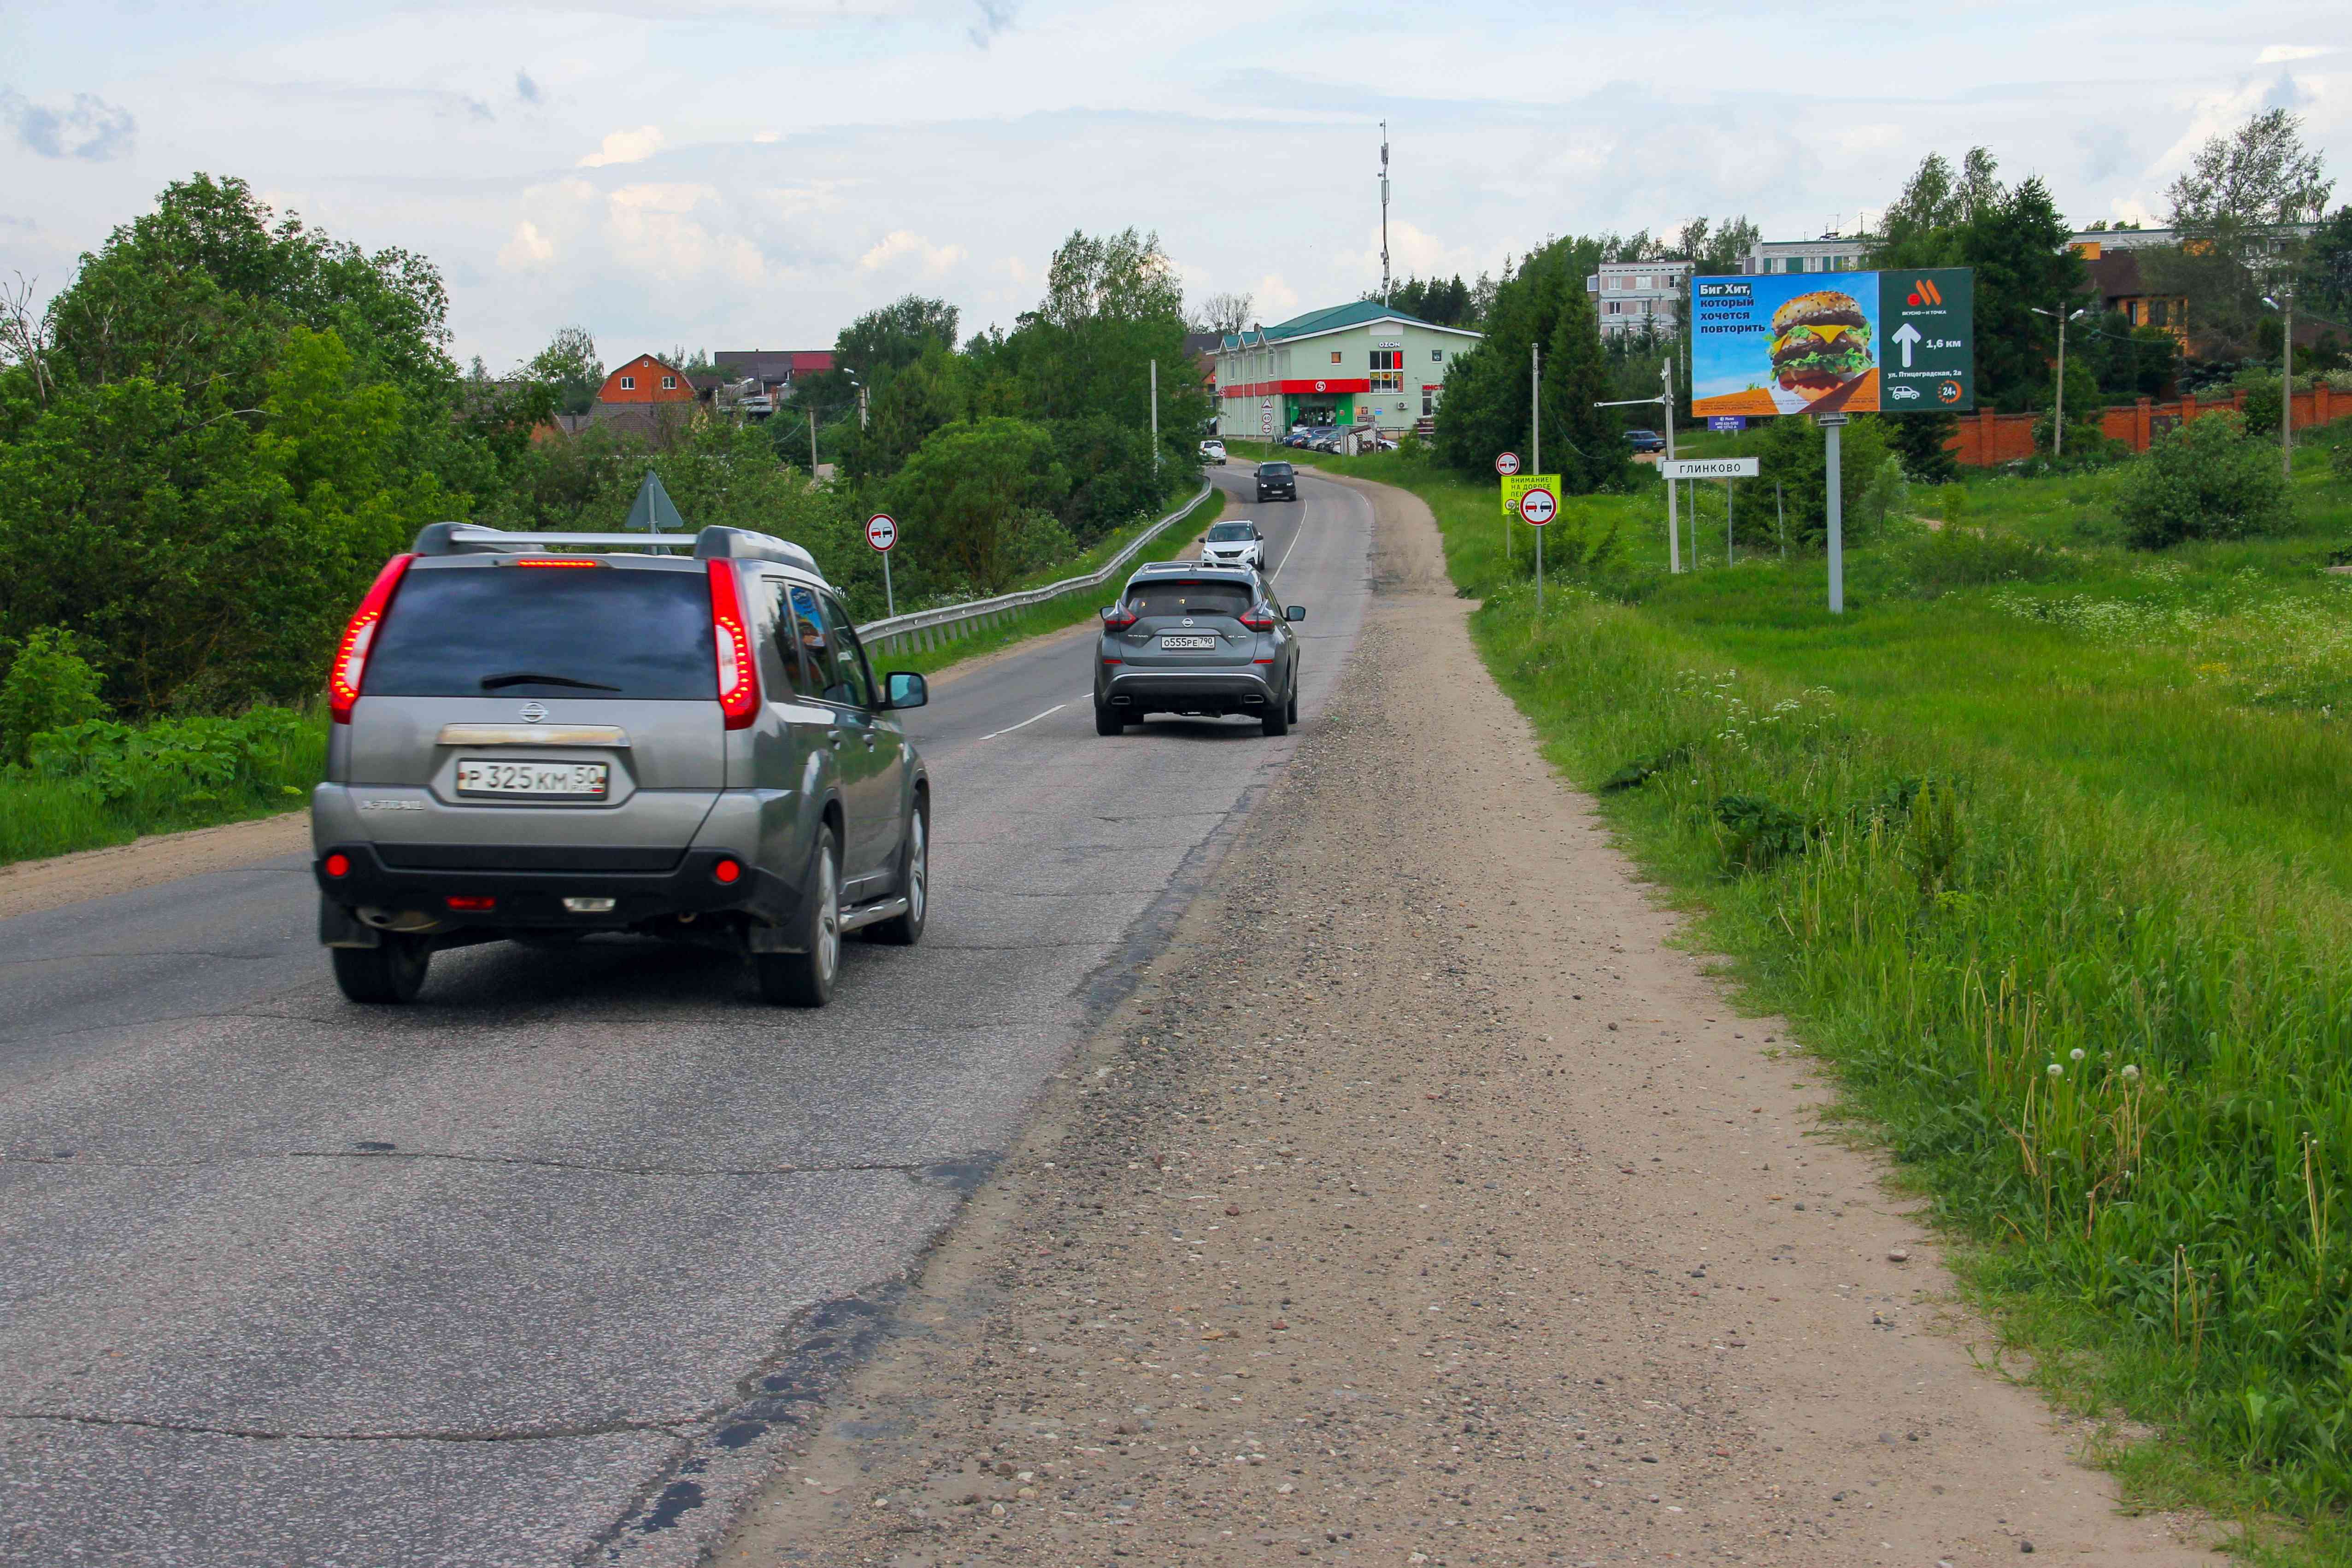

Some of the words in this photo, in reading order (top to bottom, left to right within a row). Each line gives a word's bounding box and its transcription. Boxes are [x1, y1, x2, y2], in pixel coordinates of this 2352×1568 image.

[1700, 284, 1723, 295] Биг
[1725, 284, 1751, 295] Хит,
[1700, 296, 1754, 309] который
[1700, 312, 1750, 321] хочется
[1700, 324, 1765, 335] повторить
[1926, 339, 1944, 350] 1,6
[1680, 463, 1740, 474] ГЛИНКОВО
